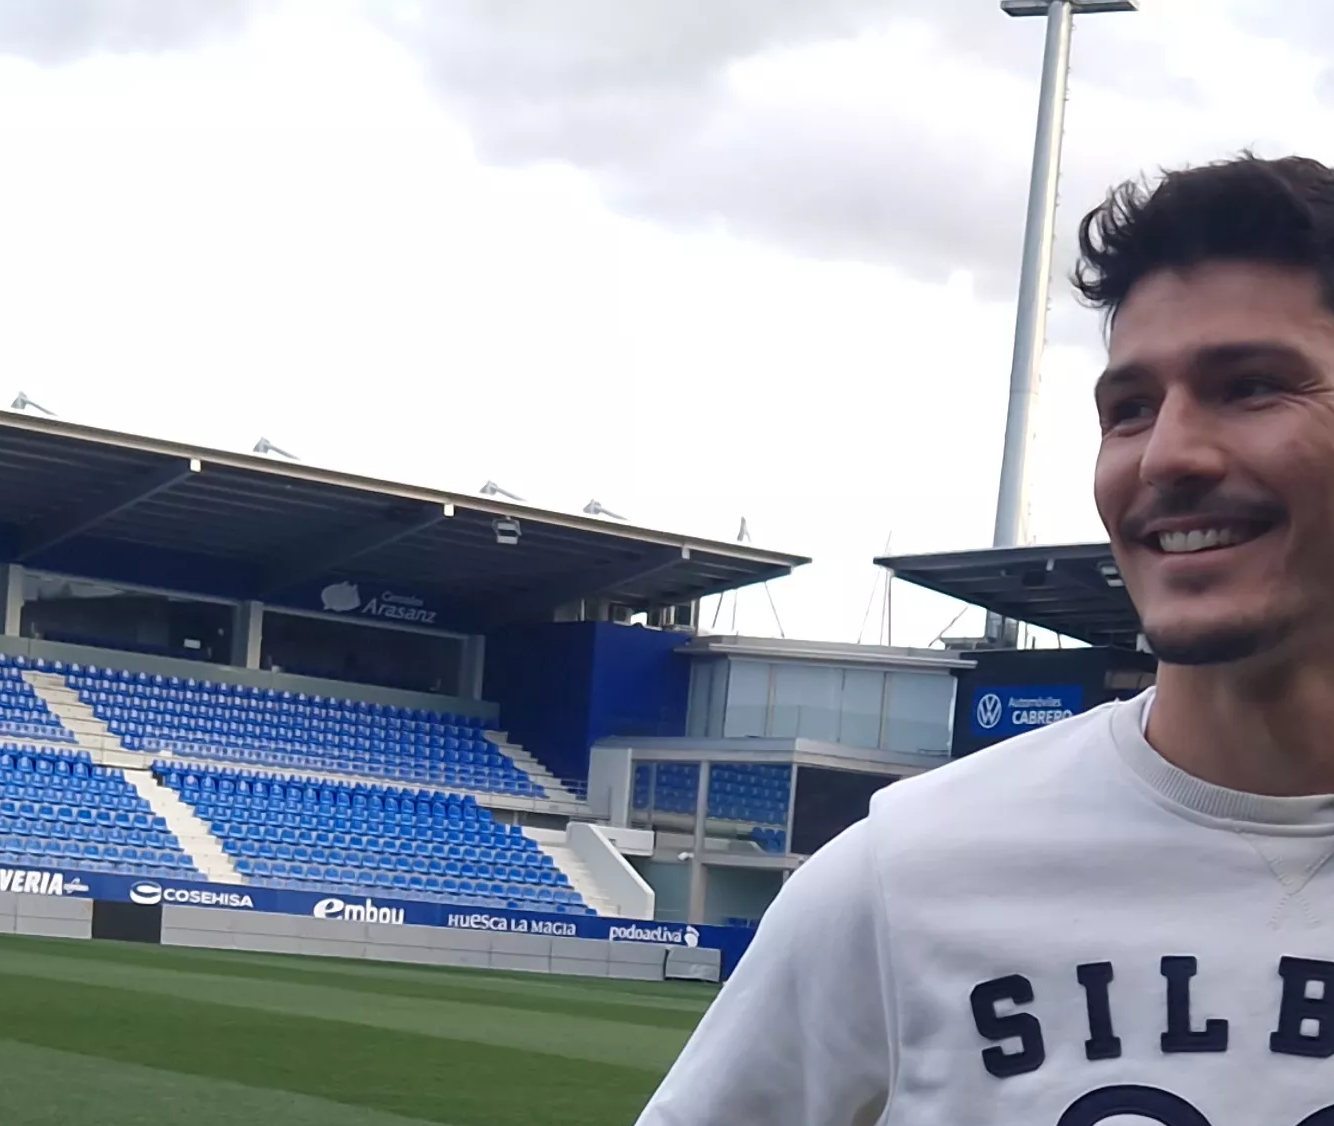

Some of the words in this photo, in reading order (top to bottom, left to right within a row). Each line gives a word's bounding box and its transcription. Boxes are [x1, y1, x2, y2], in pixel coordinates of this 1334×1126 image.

[362, 597, 438, 624] Arasanz
[163, 888, 254, 908] COSEHISA
[313, 898, 405, 925] embou
[609, 924, 684, 943] podoactiva
